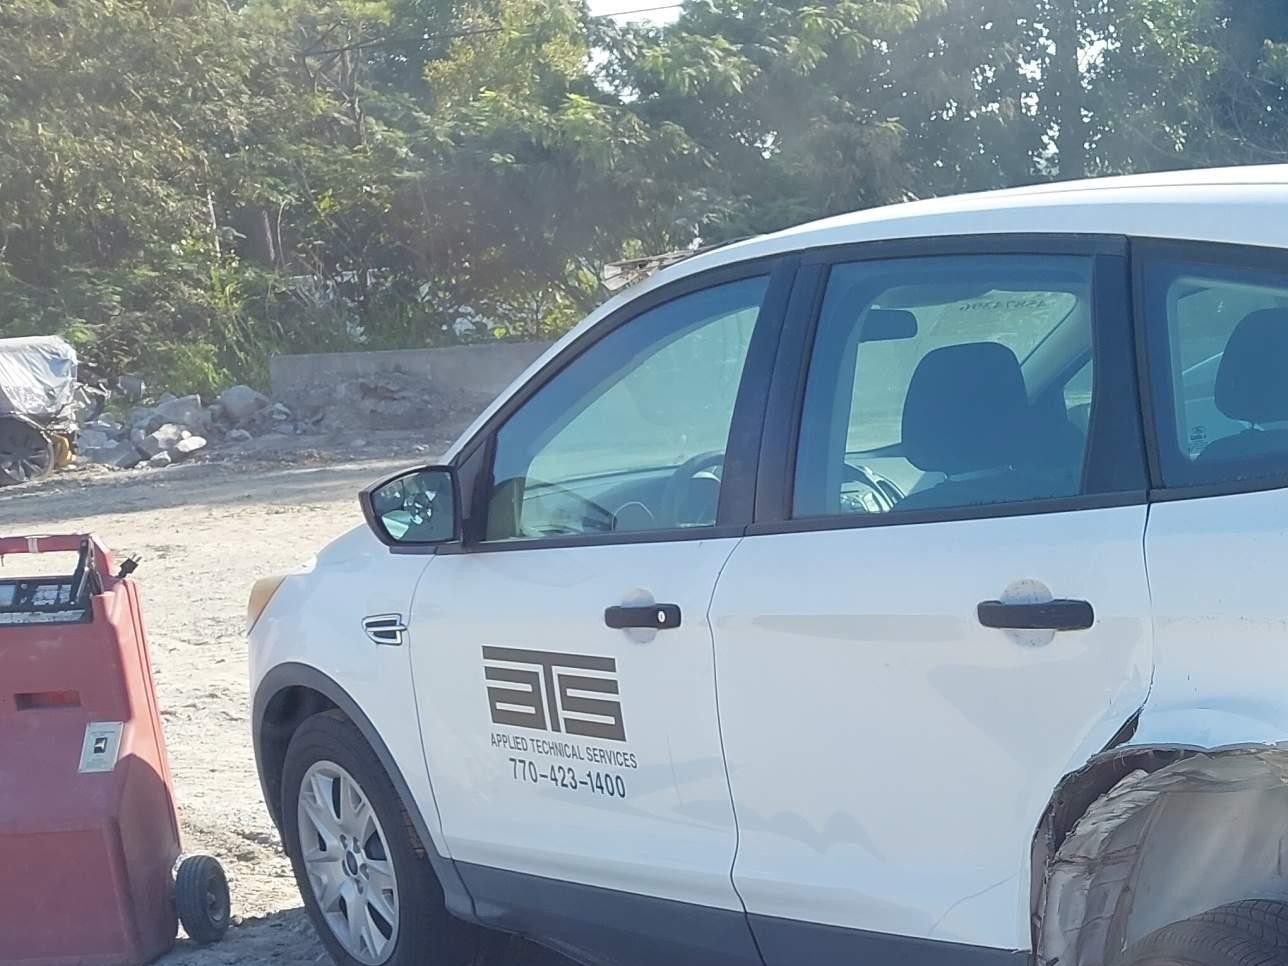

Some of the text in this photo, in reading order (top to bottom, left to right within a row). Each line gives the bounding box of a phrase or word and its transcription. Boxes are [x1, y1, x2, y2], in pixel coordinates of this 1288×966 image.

[490, 733, 638, 769] APPLIED TECHNICAL SERVICES
[508, 757, 627, 798] 770-423-1400
